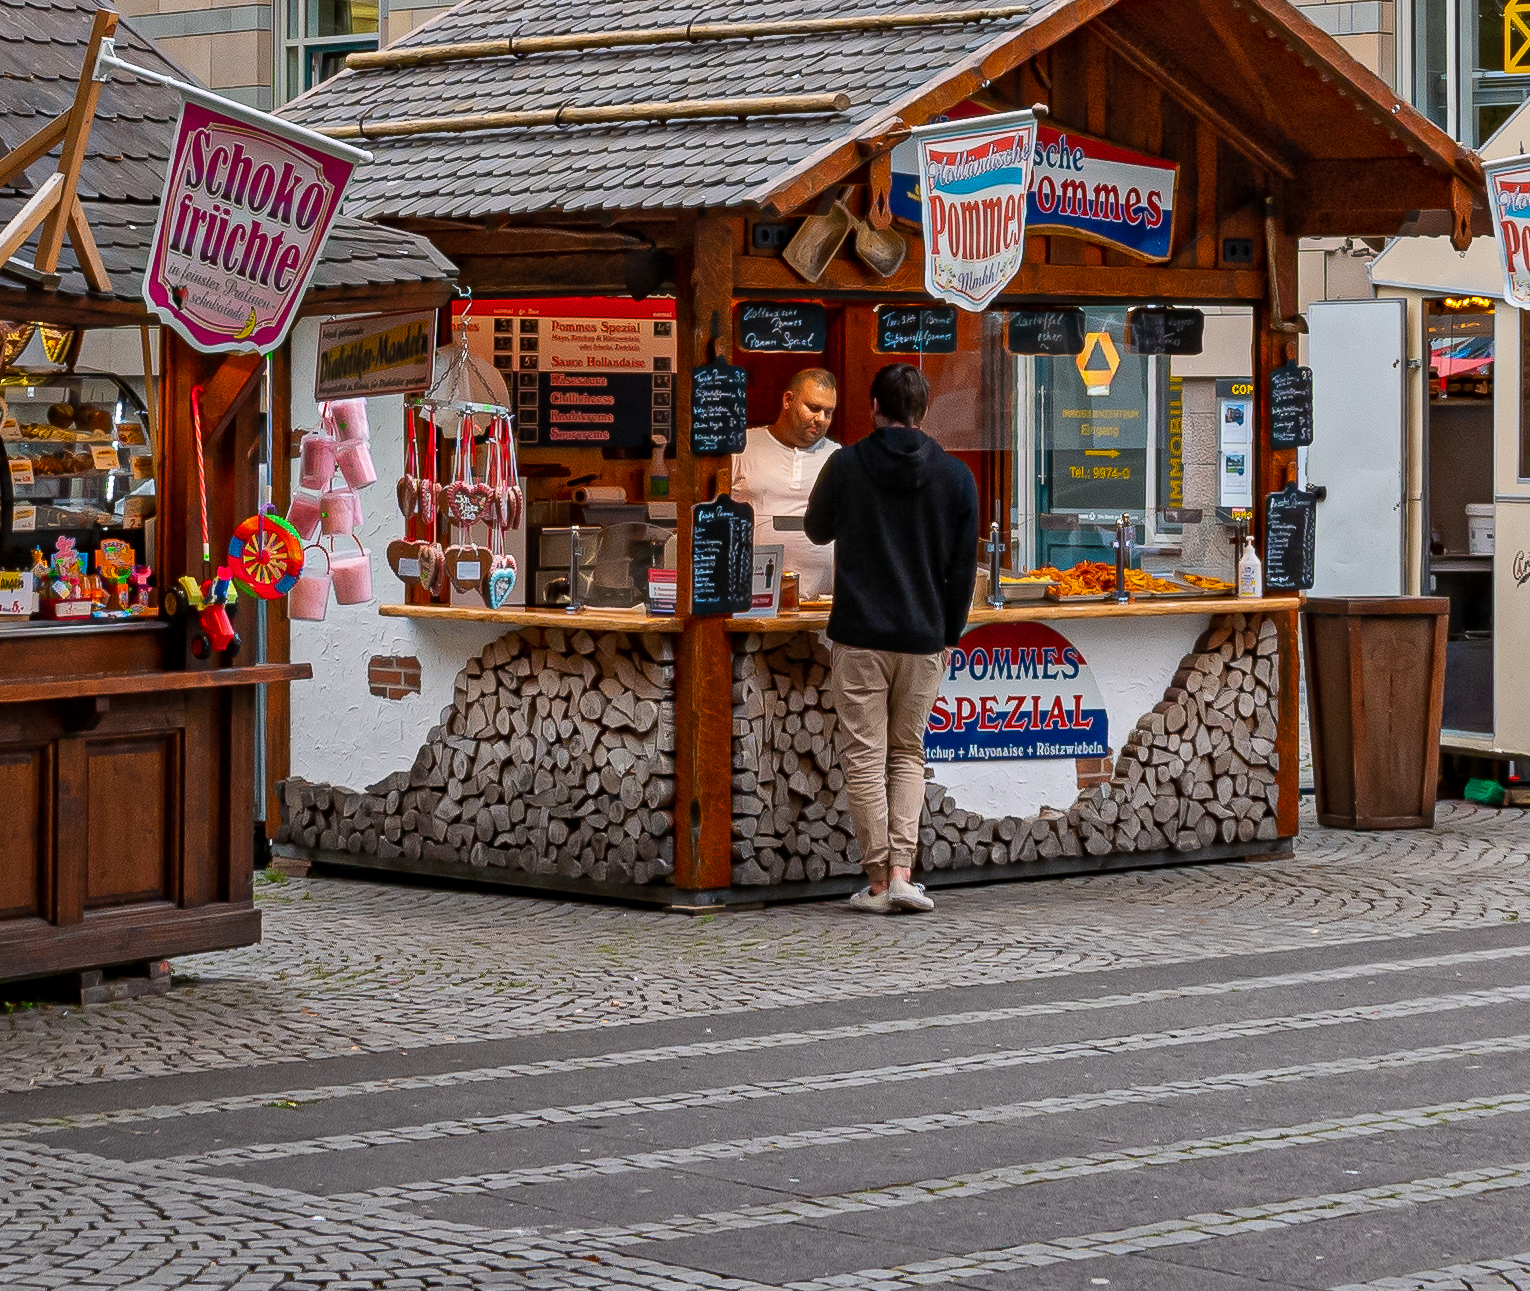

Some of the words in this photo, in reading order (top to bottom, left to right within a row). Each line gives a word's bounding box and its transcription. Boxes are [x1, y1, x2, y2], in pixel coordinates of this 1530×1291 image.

[185, 127, 326, 232] Schoko
[1028, 168, 1164, 228] ommes
[169, 194, 302, 293] früchte
[958, 265, 1000, 291] Mmhh!
[551, 321, 597, 333] Pommes
[601, 321, 641, 334] Spezial
[551, 356, 583, 368] Sauce
[587, 356, 646, 368] Hollandaise
[948, 647, 1080, 682] POMMES
[927, 694, 1095, 734] SPEZIAL
[969, 744, 1024, 759] Mayonaise
[1036, 741, 1106, 756] Röstzwiebeln
